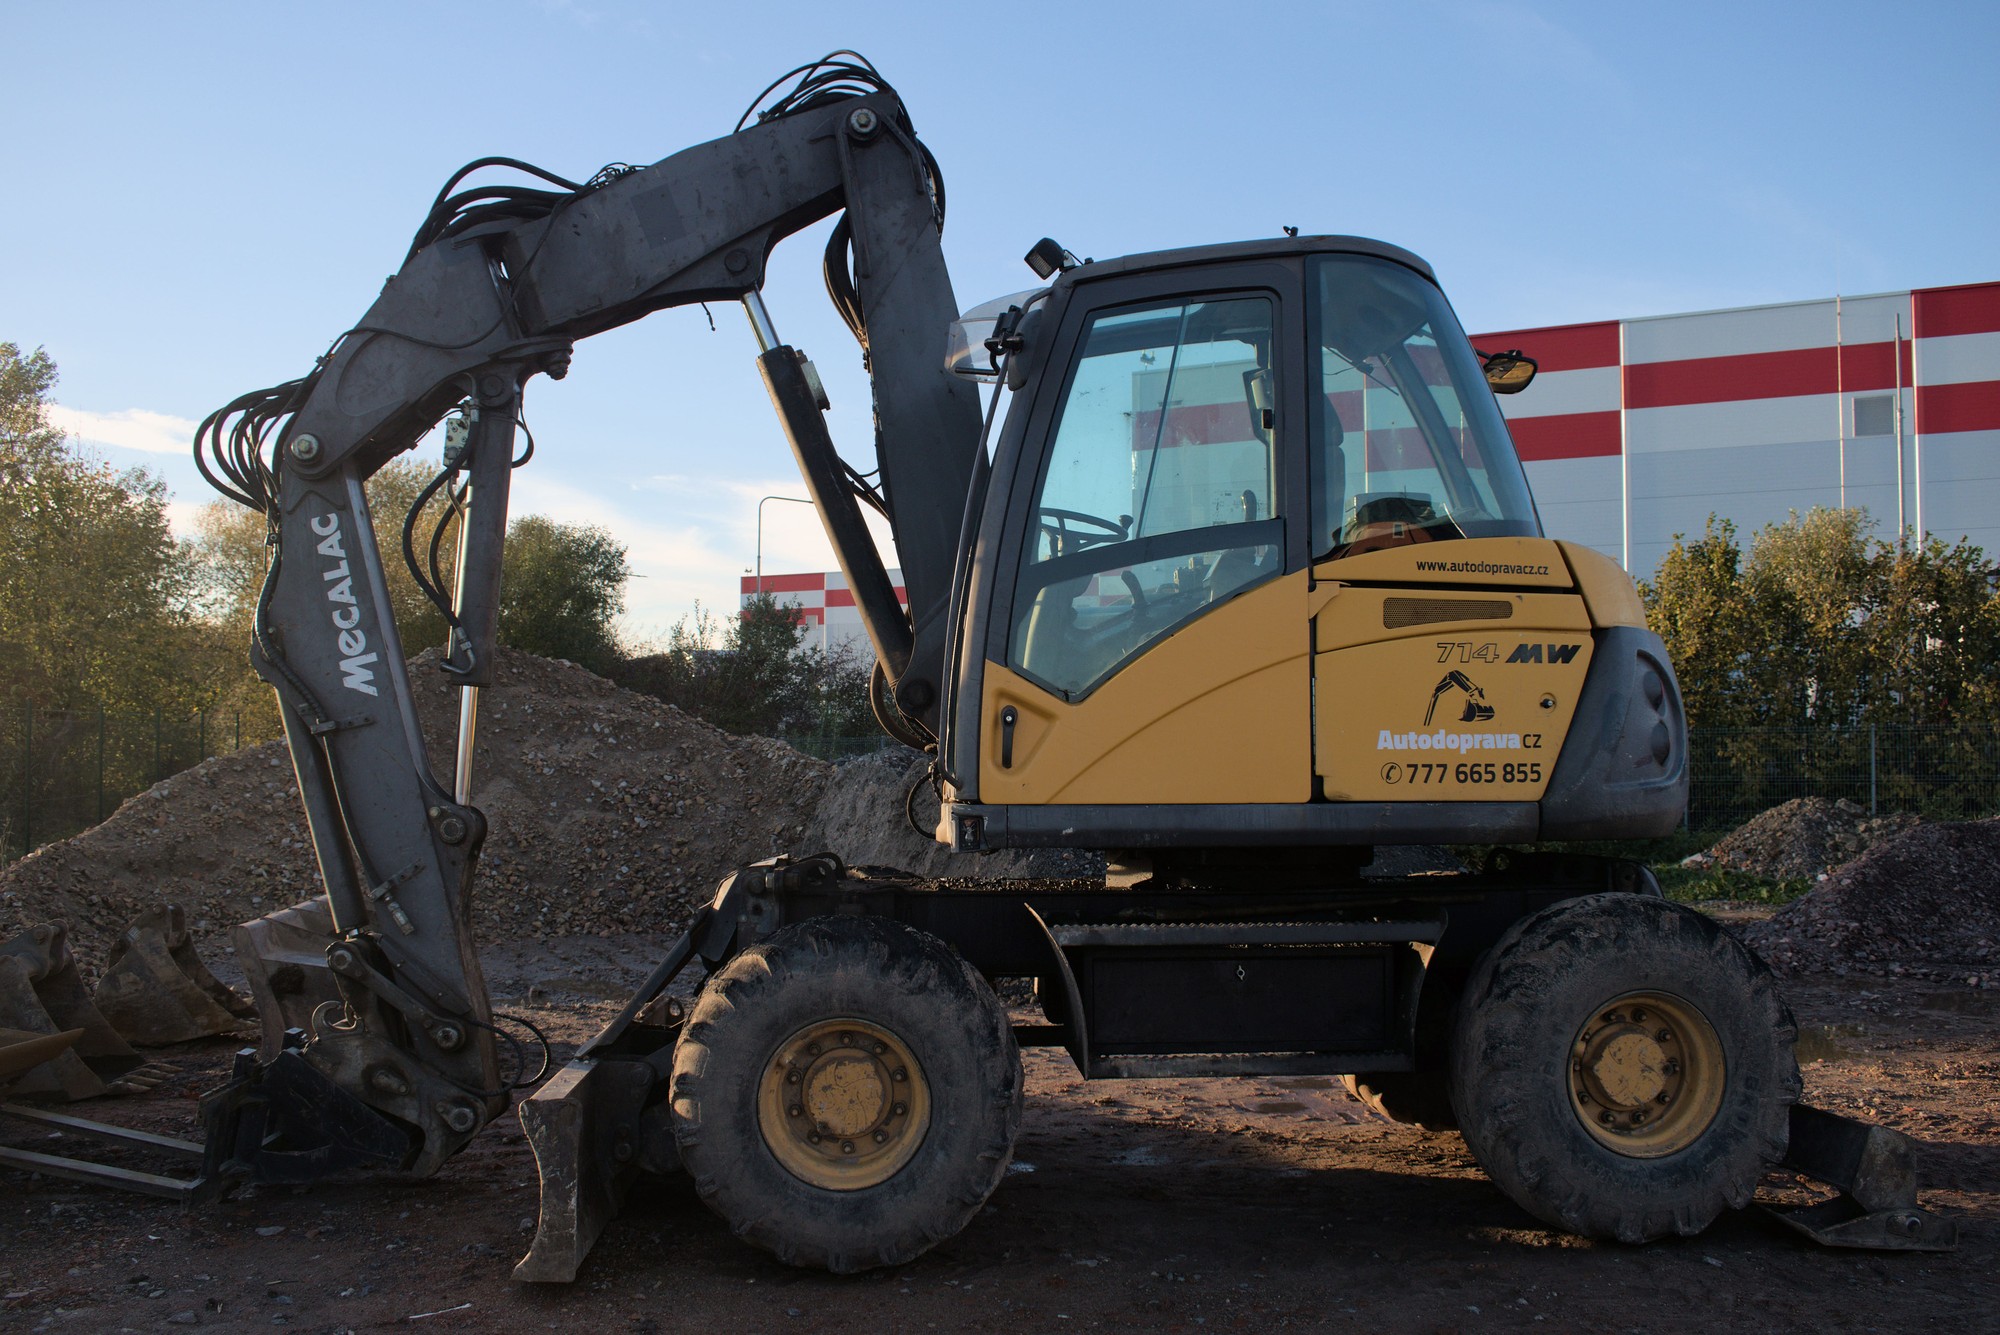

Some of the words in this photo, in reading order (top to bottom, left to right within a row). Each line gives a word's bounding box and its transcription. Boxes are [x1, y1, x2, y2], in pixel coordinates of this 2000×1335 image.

[1416, 560, 1549, 576] www.autodopravacz.cz
[1437, 642, 1500, 664] 714
[1505, 643, 1582, 664] MW
[1377, 729, 1521, 754] Autodoprava
[1406, 764, 1448, 784] 777
[1455, 763, 1496, 783] 665
[1502, 763, 1542, 783] 855
